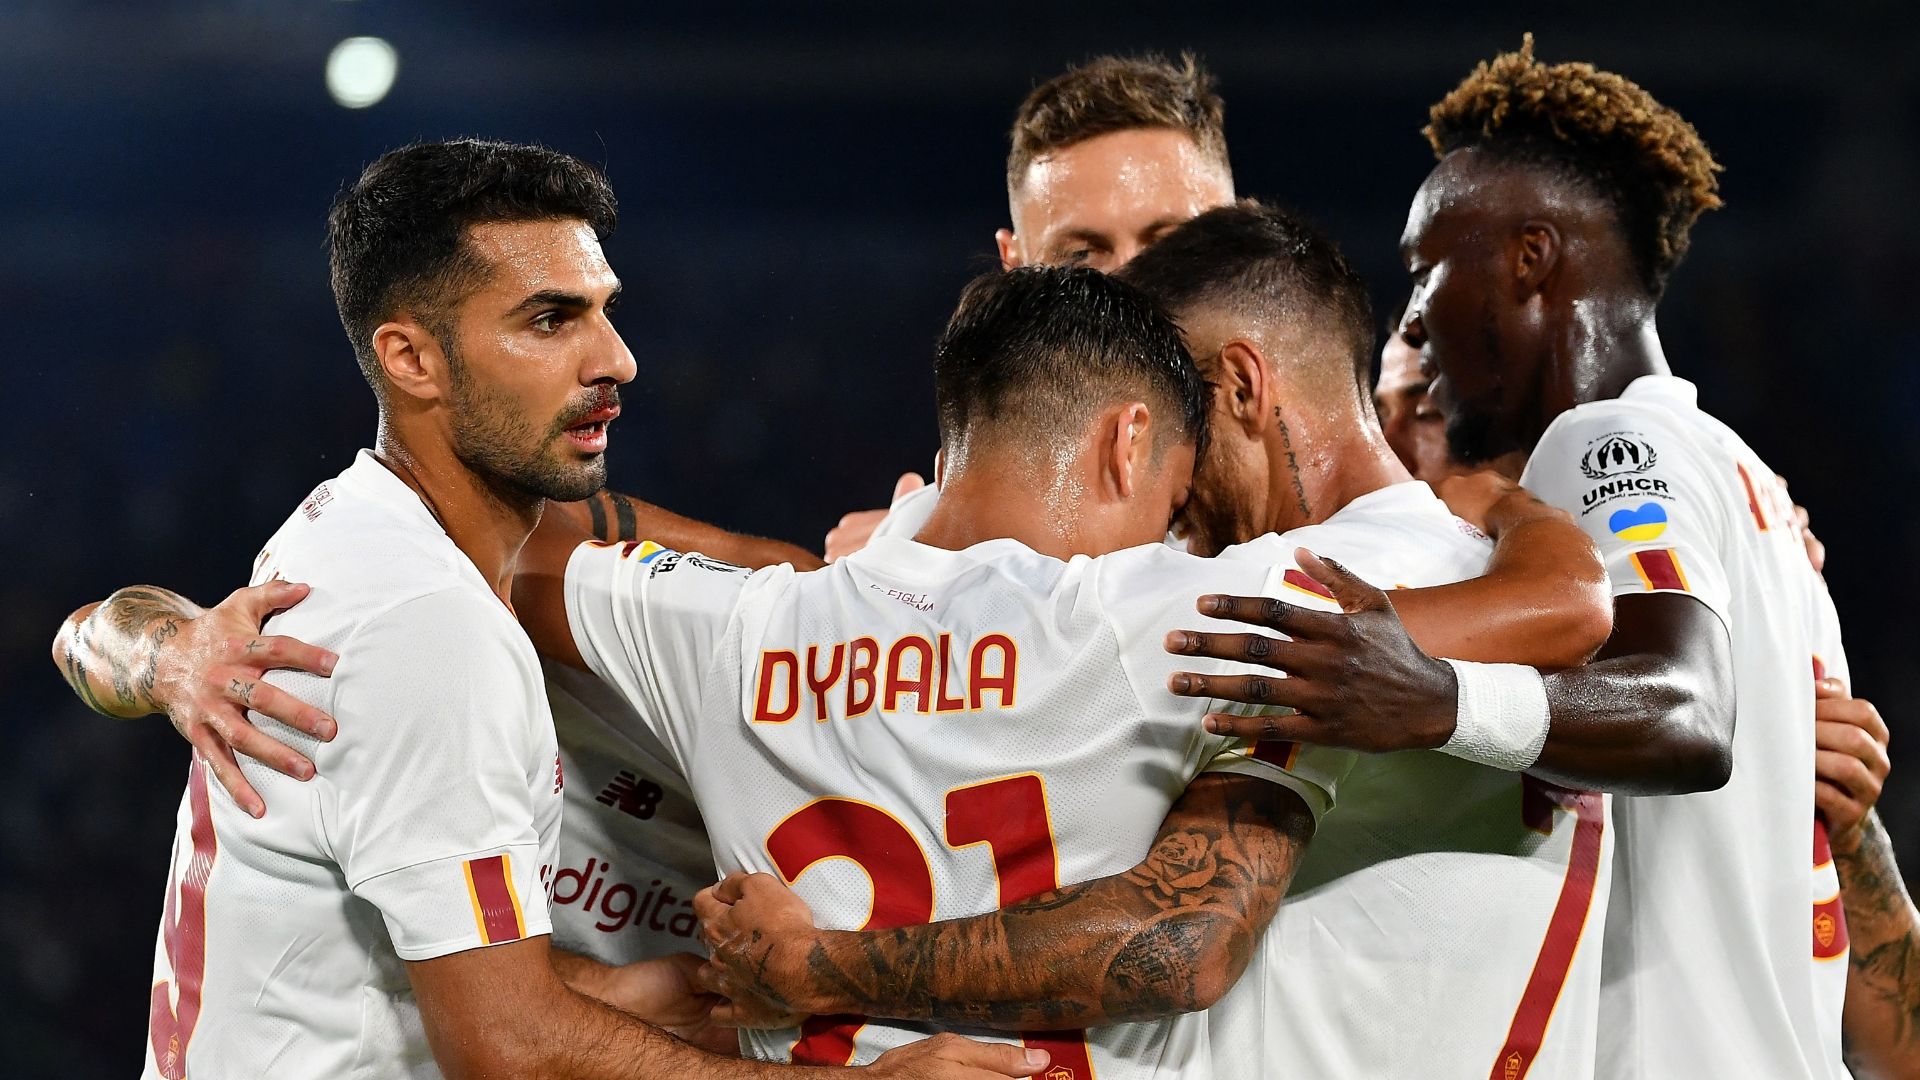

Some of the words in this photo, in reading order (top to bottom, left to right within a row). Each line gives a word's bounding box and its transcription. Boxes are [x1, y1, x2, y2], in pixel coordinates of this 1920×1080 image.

[1582, 479, 1669, 506] UNHCR
[752, 632, 1019, 724] DYBALA
[552, 857, 702, 940] digita
[765, 771, 1096, 1080] 21
[1488, 764, 1605, 1080] 7
